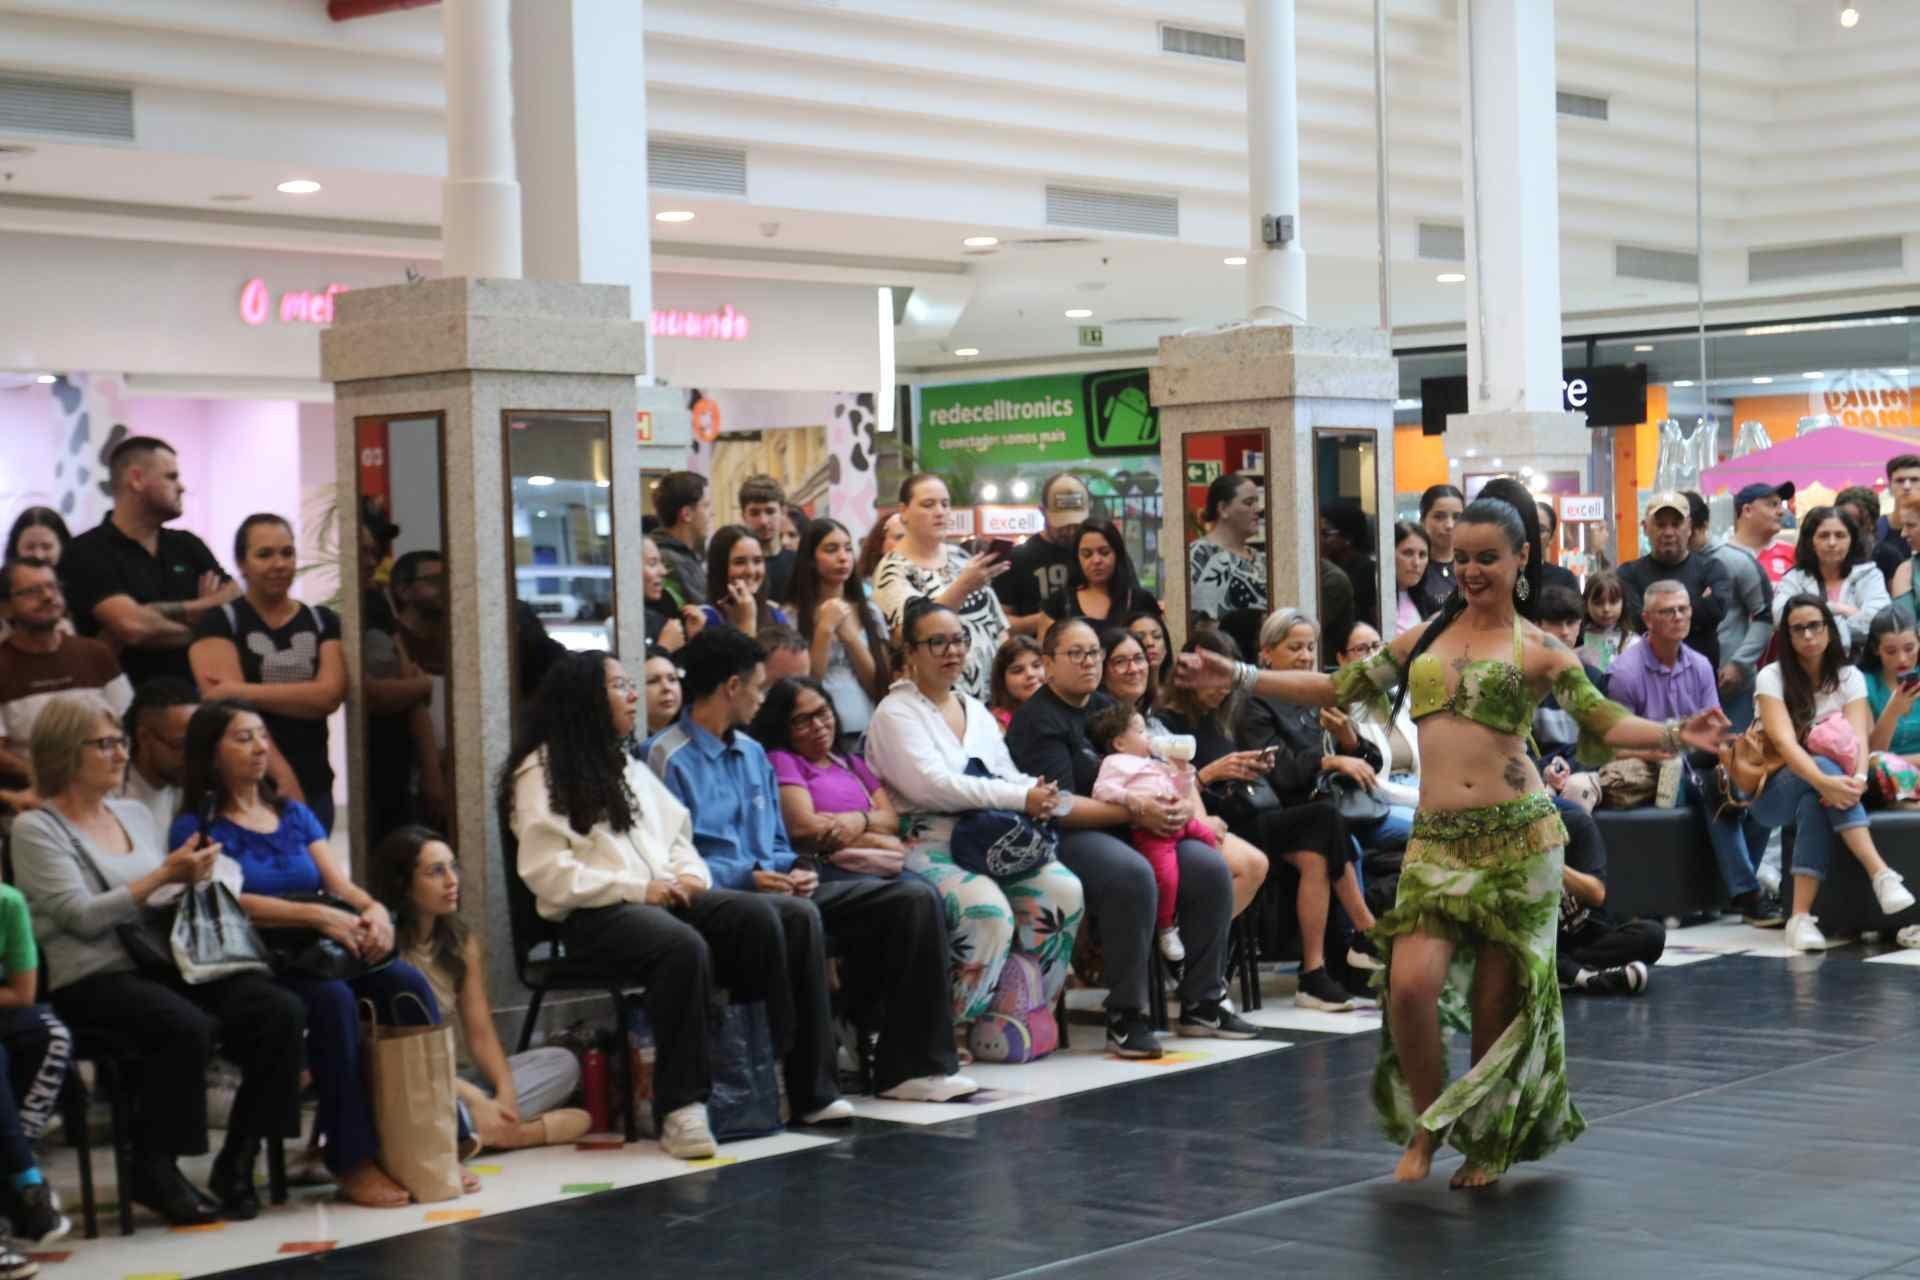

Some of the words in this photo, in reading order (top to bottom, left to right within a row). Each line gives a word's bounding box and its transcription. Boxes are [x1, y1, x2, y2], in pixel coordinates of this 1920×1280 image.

[239, 276, 270, 325] O
[929, 396, 1073, 426] redecelltronics
[989, 509, 1037, 530] excell
[1566, 501, 1600, 517] excell
